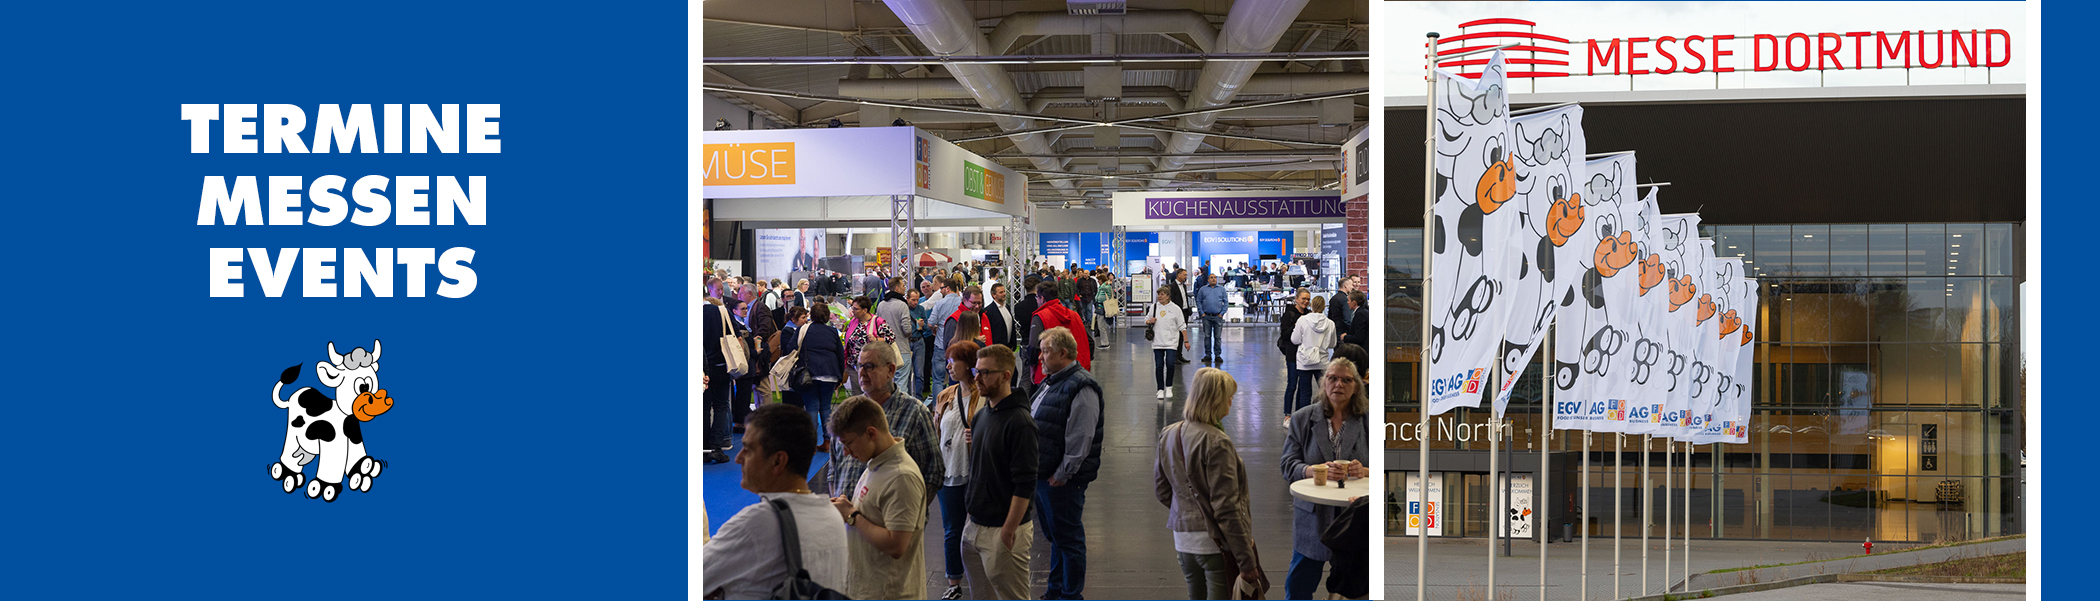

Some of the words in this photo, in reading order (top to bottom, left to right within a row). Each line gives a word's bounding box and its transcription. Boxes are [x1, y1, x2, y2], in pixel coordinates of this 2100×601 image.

[1587, 34, 1735, 76] MESSE
[1754, 29, 2011, 72] DORTMUND
[1149, 199, 1346, 217] KÜCHENAUSSTATTUNG
[1557, 401, 1582, 415] EGV
[1589, 401, 1605, 415] AG
[1628, 406, 1649, 419] AG
[1662, 411, 1678, 422] AG
